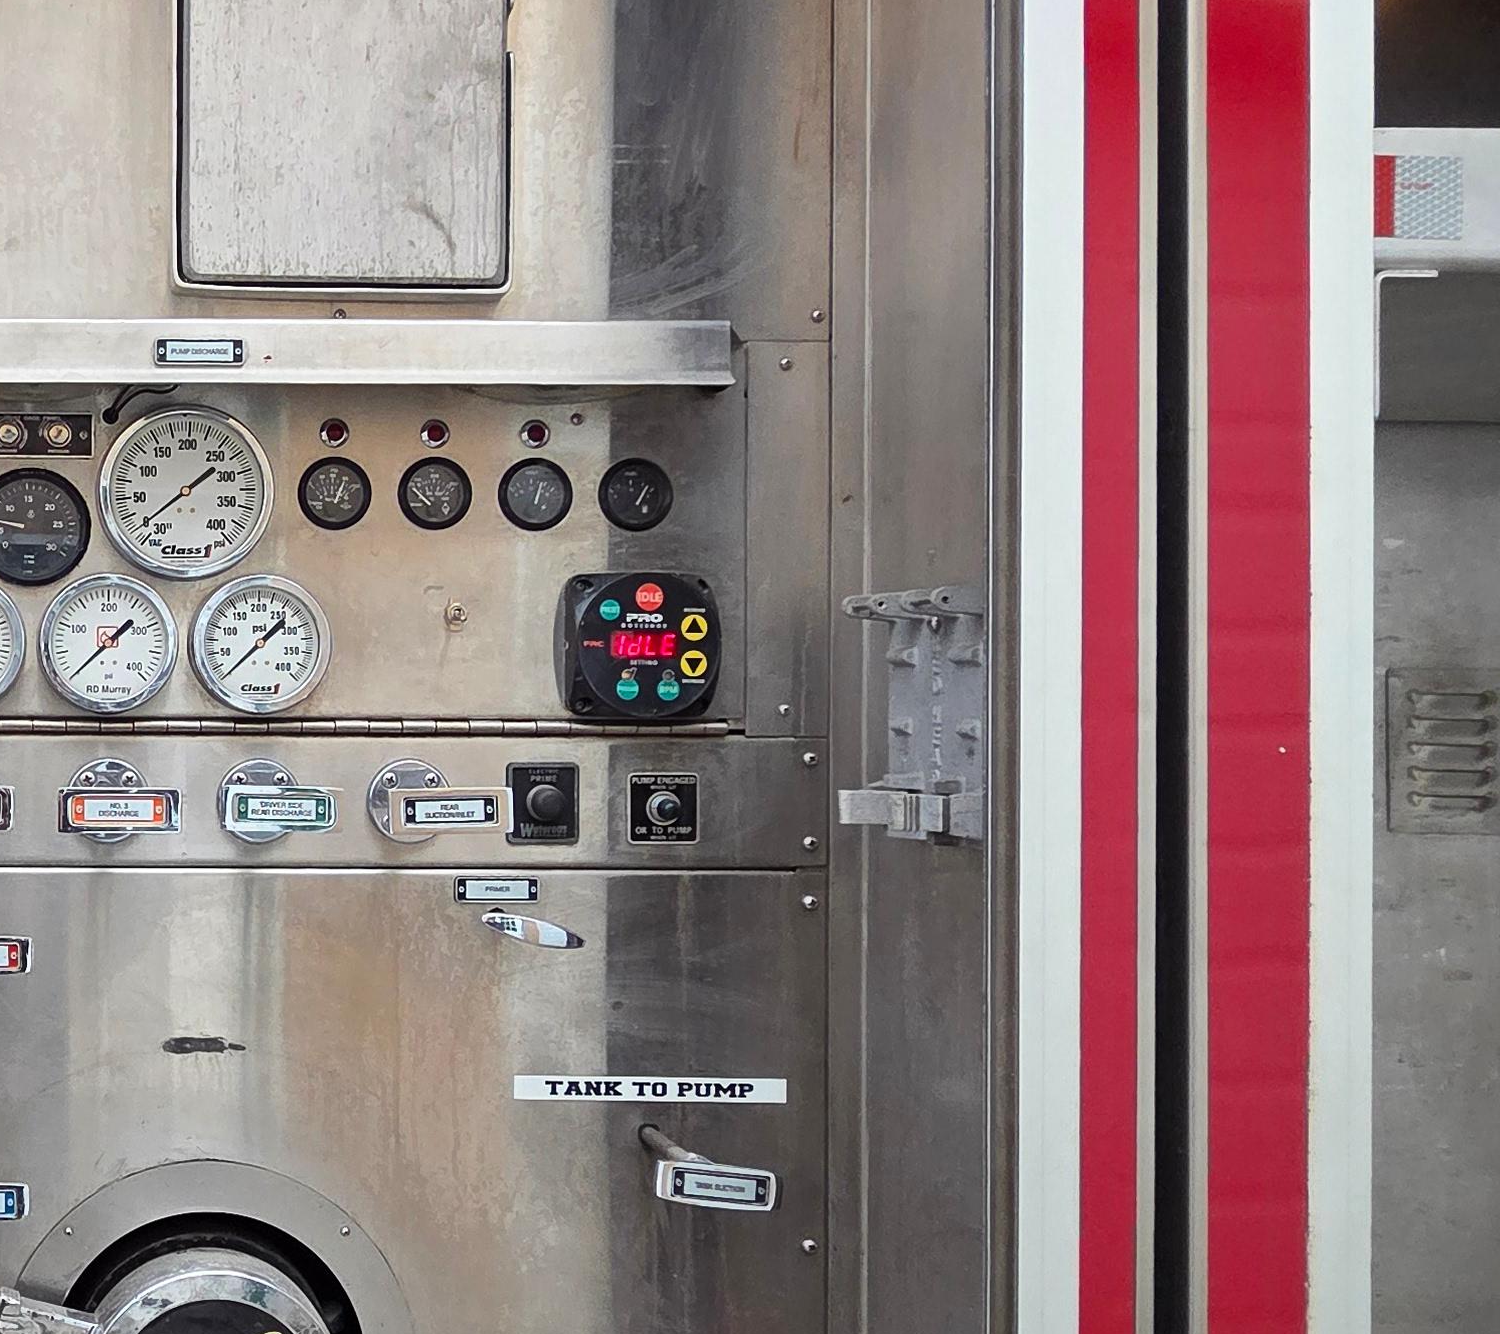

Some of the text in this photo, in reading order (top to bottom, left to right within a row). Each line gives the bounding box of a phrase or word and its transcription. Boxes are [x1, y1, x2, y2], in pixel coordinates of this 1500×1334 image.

[171, 348, 229, 356] PUMP DISCHARGE
[178, 439, 197, 450] 200
[154, 447, 171, 458] 150
[206, 450, 225, 462] 250
[140, 466, 157, 477] 100
[216, 471, 235, 482] 300
[24, 495, 33, 503] 15
[133, 492, 146, 503] 50
[217, 496, 236, 507] 350
[154, 523, 172, 534] 30"
[206, 519, 225, 530] 400
[214, 539, 225, 549] psi
[637, 592, 663, 603] IDLE
[101, 602, 118, 612] 200
[251, 604, 267, 612] 200
[233, 612, 247, 620] 150
[270, 611, 286, 620] 250
[626, 613, 663, 623] PRO
[71, 625, 87, 633] 100
[130, 626, 147, 635] 300
[223, 627, 237, 636] 100
[252, 624, 267, 634] psi
[282, 627, 298, 635] 300
[220, 648, 231, 656] 50
[284, 647, 299, 655] 350
[126, 662, 142, 671] 400
[275, 663, 291, 671] 400
[86, 685, 132, 695] RD Murray
[260, 801, 287, 809] DRIVER
[98, 809, 140, 818] DISCHARGE
[251, 808, 313, 817] REAR DISCHARGE
[545, 1080, 754, 1098] TANK TO PUMP
